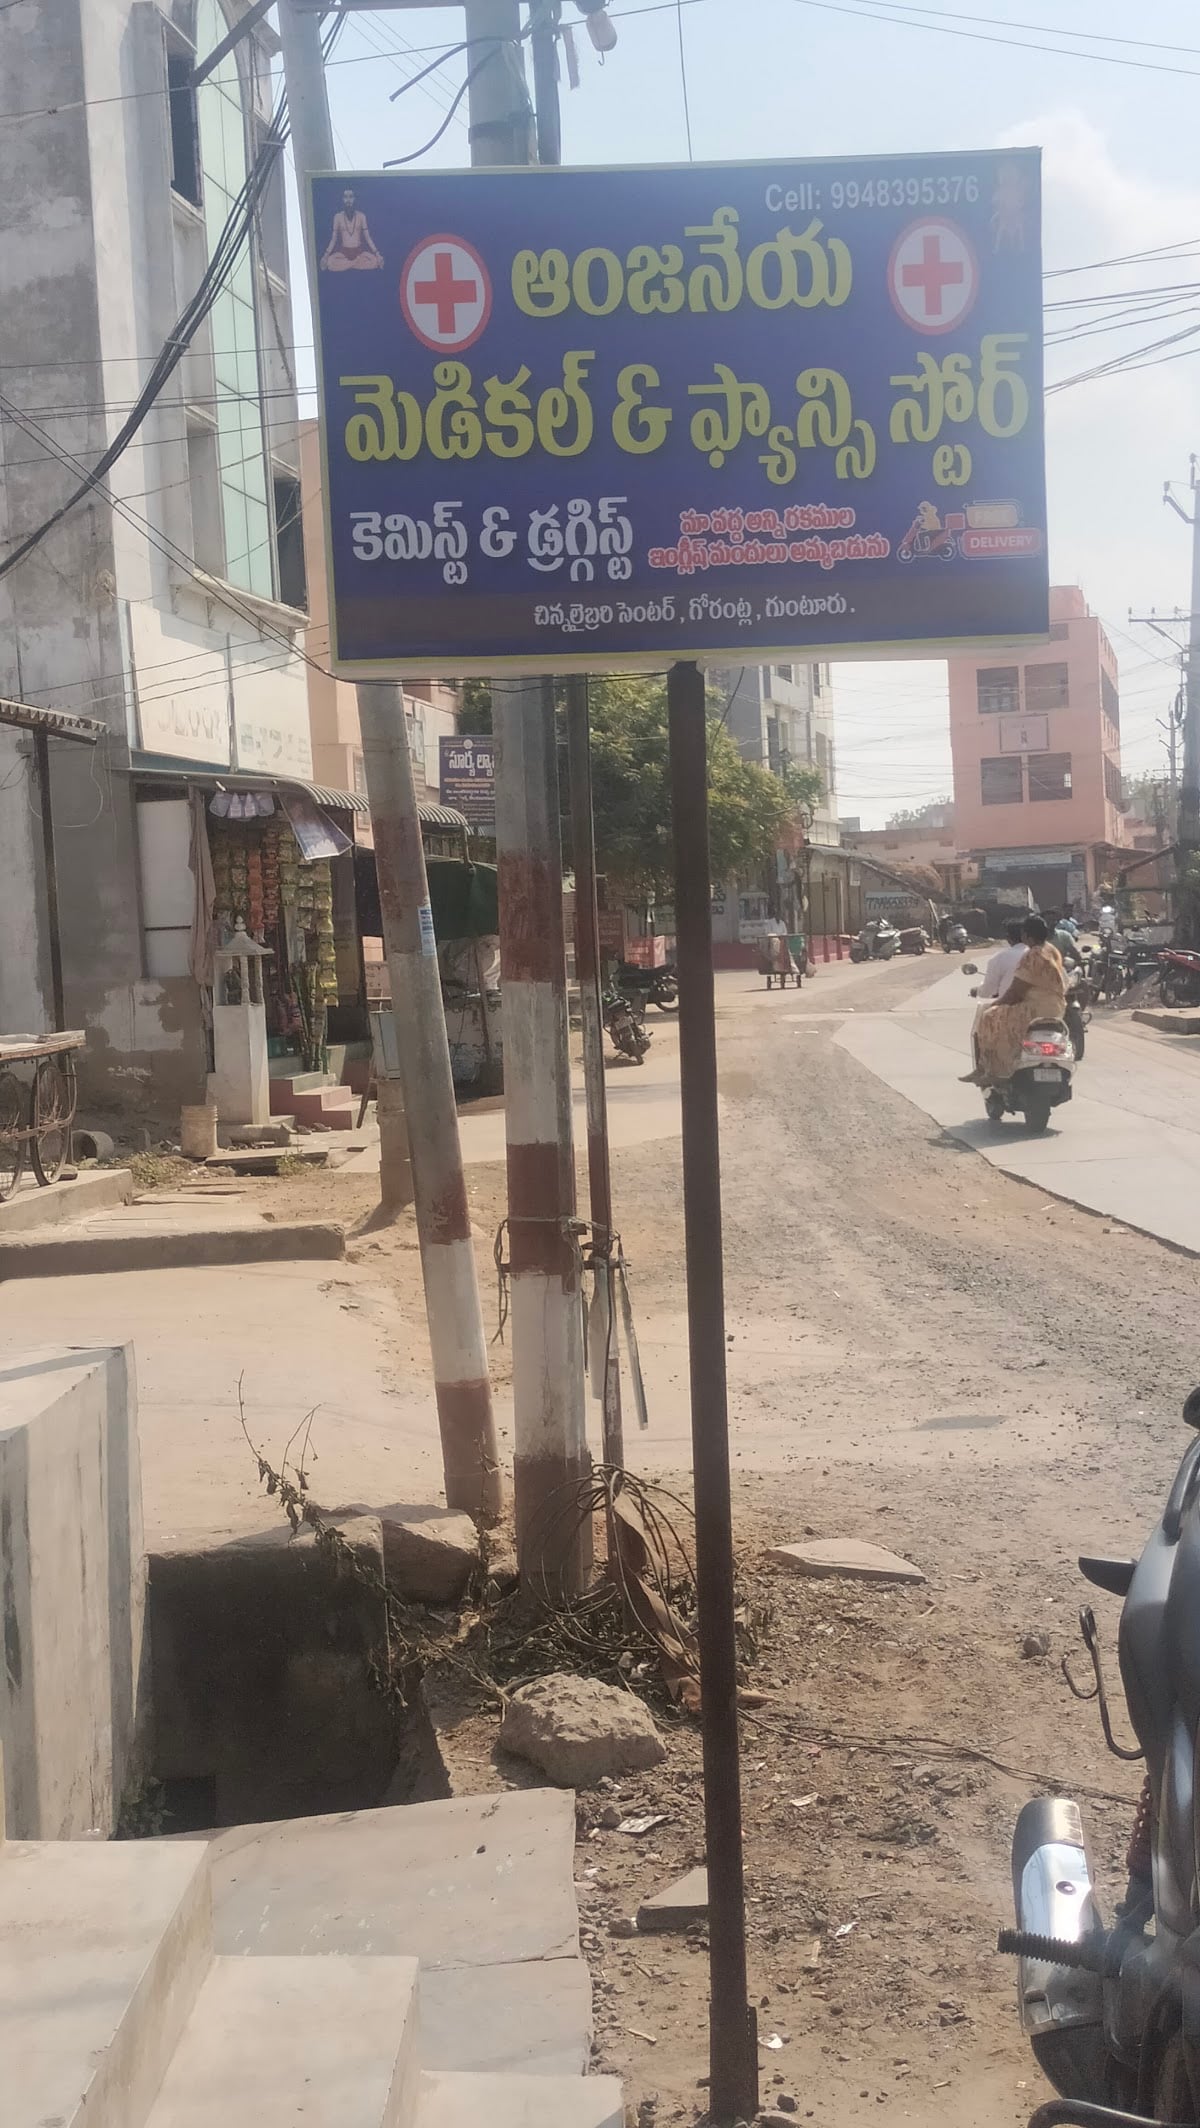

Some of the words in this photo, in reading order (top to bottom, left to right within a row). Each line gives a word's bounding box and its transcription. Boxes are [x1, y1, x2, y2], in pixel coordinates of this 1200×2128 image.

[765, 183, 822, 213] Cell:
[830, 175, 980, 210] 9948395376
[511, 206, 853, 318] ఆంజనేయ
[339, 350, 596, 462] మెడికల్
[612, 363, 673, 454] &
[889, 332, 1030, 486] స్టోర్
[349, 501, 468, 584] కెమిస్ట్
[479, 506, 518, 558] &
[527, 496, 633, 582] డ్రగ్గిస్ట్
[680, 508, 711, 535] మా
[970, 535, 1033, 549] DELIVERY
